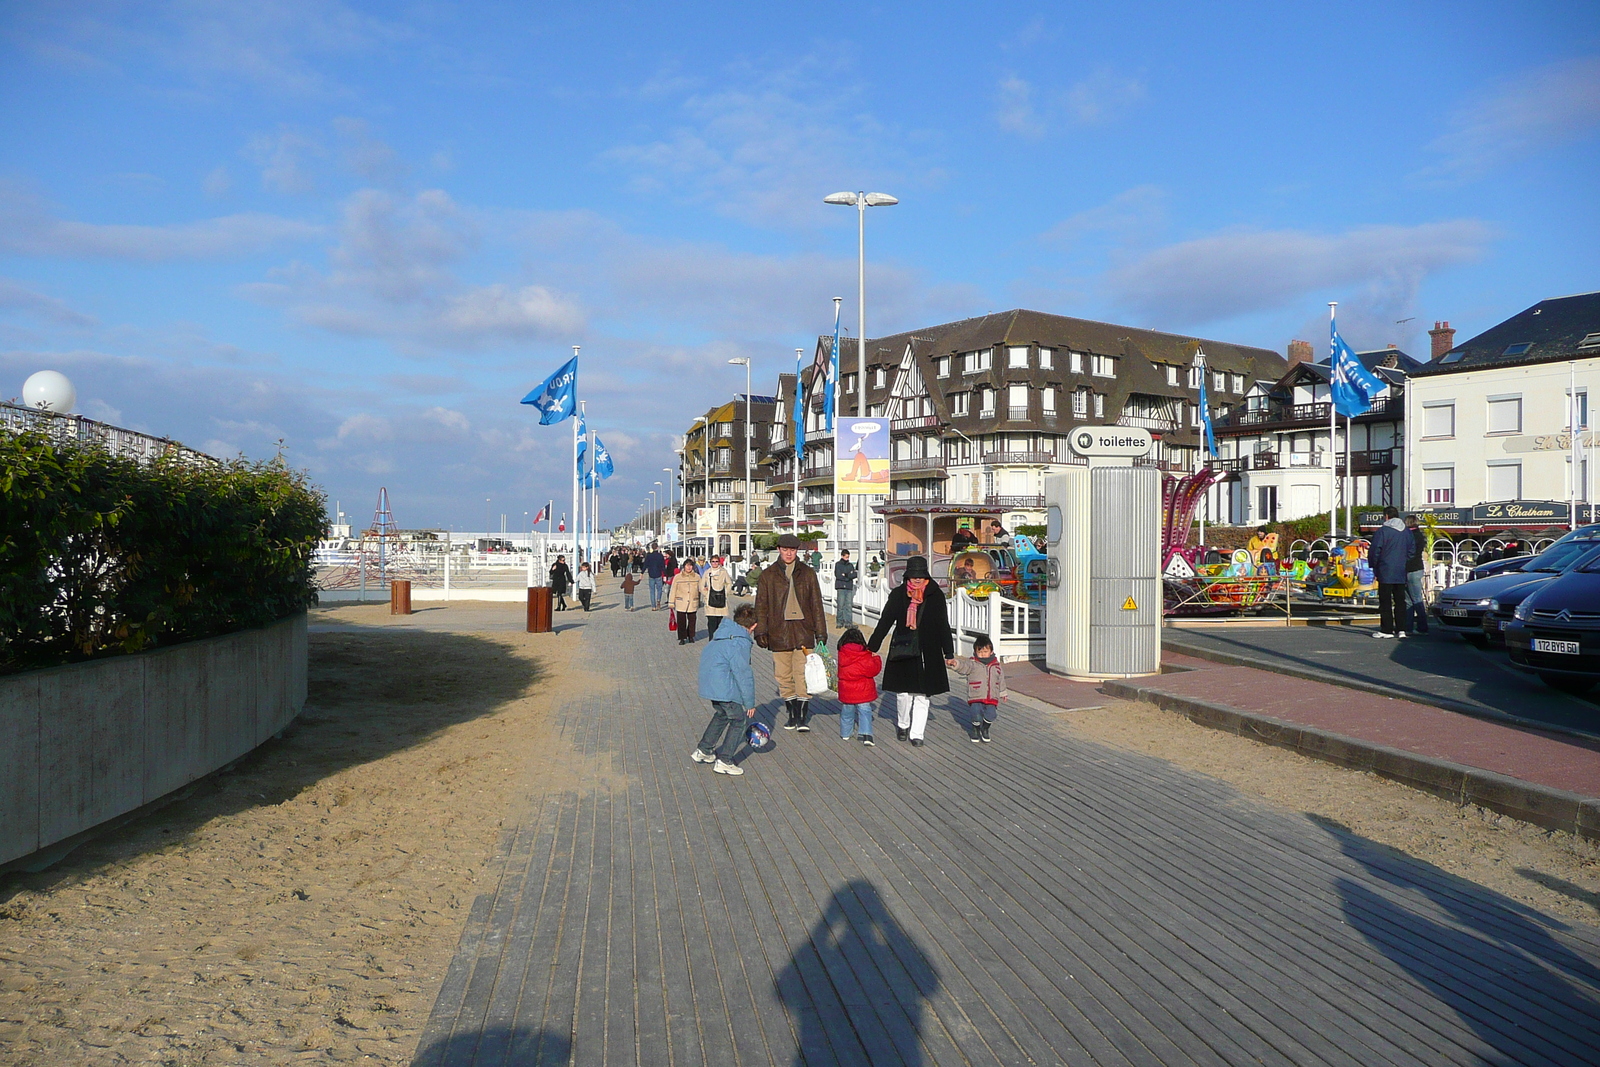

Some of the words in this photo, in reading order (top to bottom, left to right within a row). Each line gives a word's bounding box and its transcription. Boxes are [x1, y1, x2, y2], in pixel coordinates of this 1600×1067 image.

[1098, 436, 1146, 447] toilettes
[1486, 505, 1503, 517] Le
[1505, 504, 1554, 517] Chatham
[1366, 513, 1384, 522] HOT
[1538, 640, 1551, 651] 172
[1551, 641, 1566, 653] BYB
[1566, 643, 1577, 653] 60
